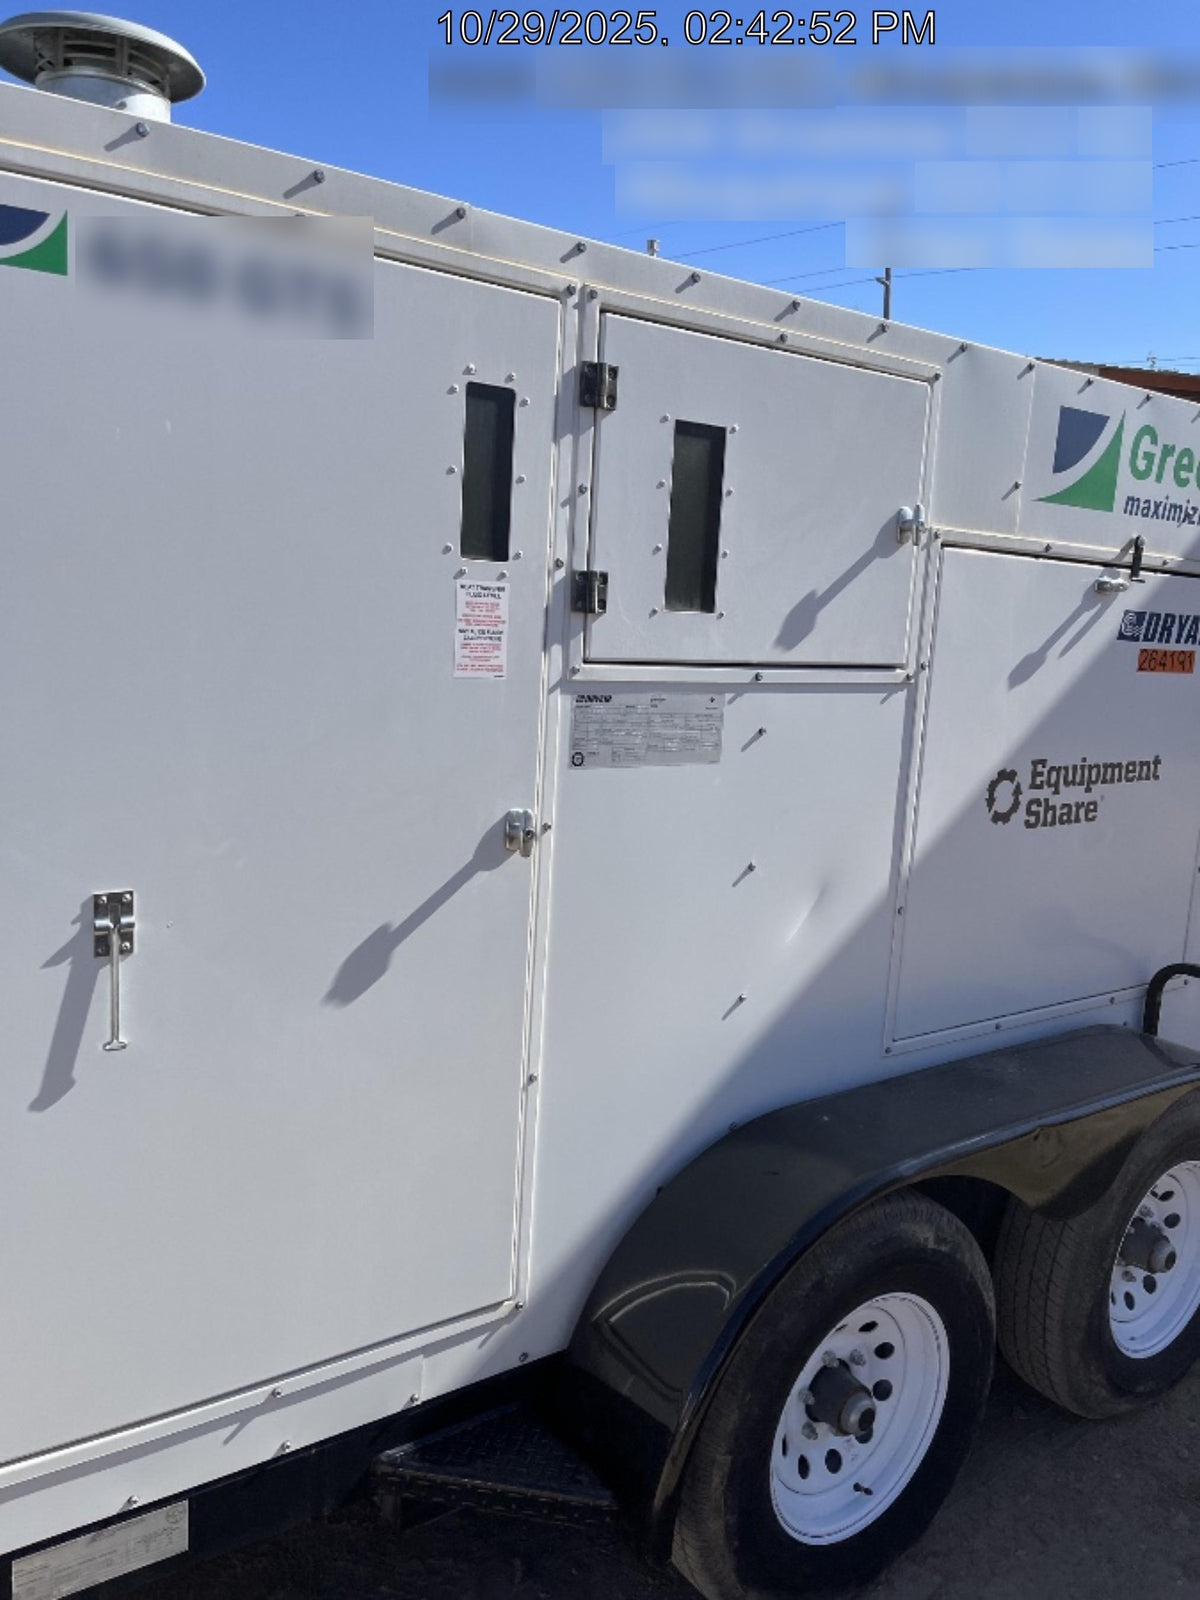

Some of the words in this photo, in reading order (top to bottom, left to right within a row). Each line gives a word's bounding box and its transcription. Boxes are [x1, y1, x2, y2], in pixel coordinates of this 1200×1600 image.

[1129, 424, 1200, 491] Gre
[1123, 494, 1200, 527] maximiz
[1141, 610, 1200, 646] DRYA
[1138, 649, 1194, 672] 264191
[1028, 754, 1162, 795] Equipment
[1024, 797, 1098, 829] Share
